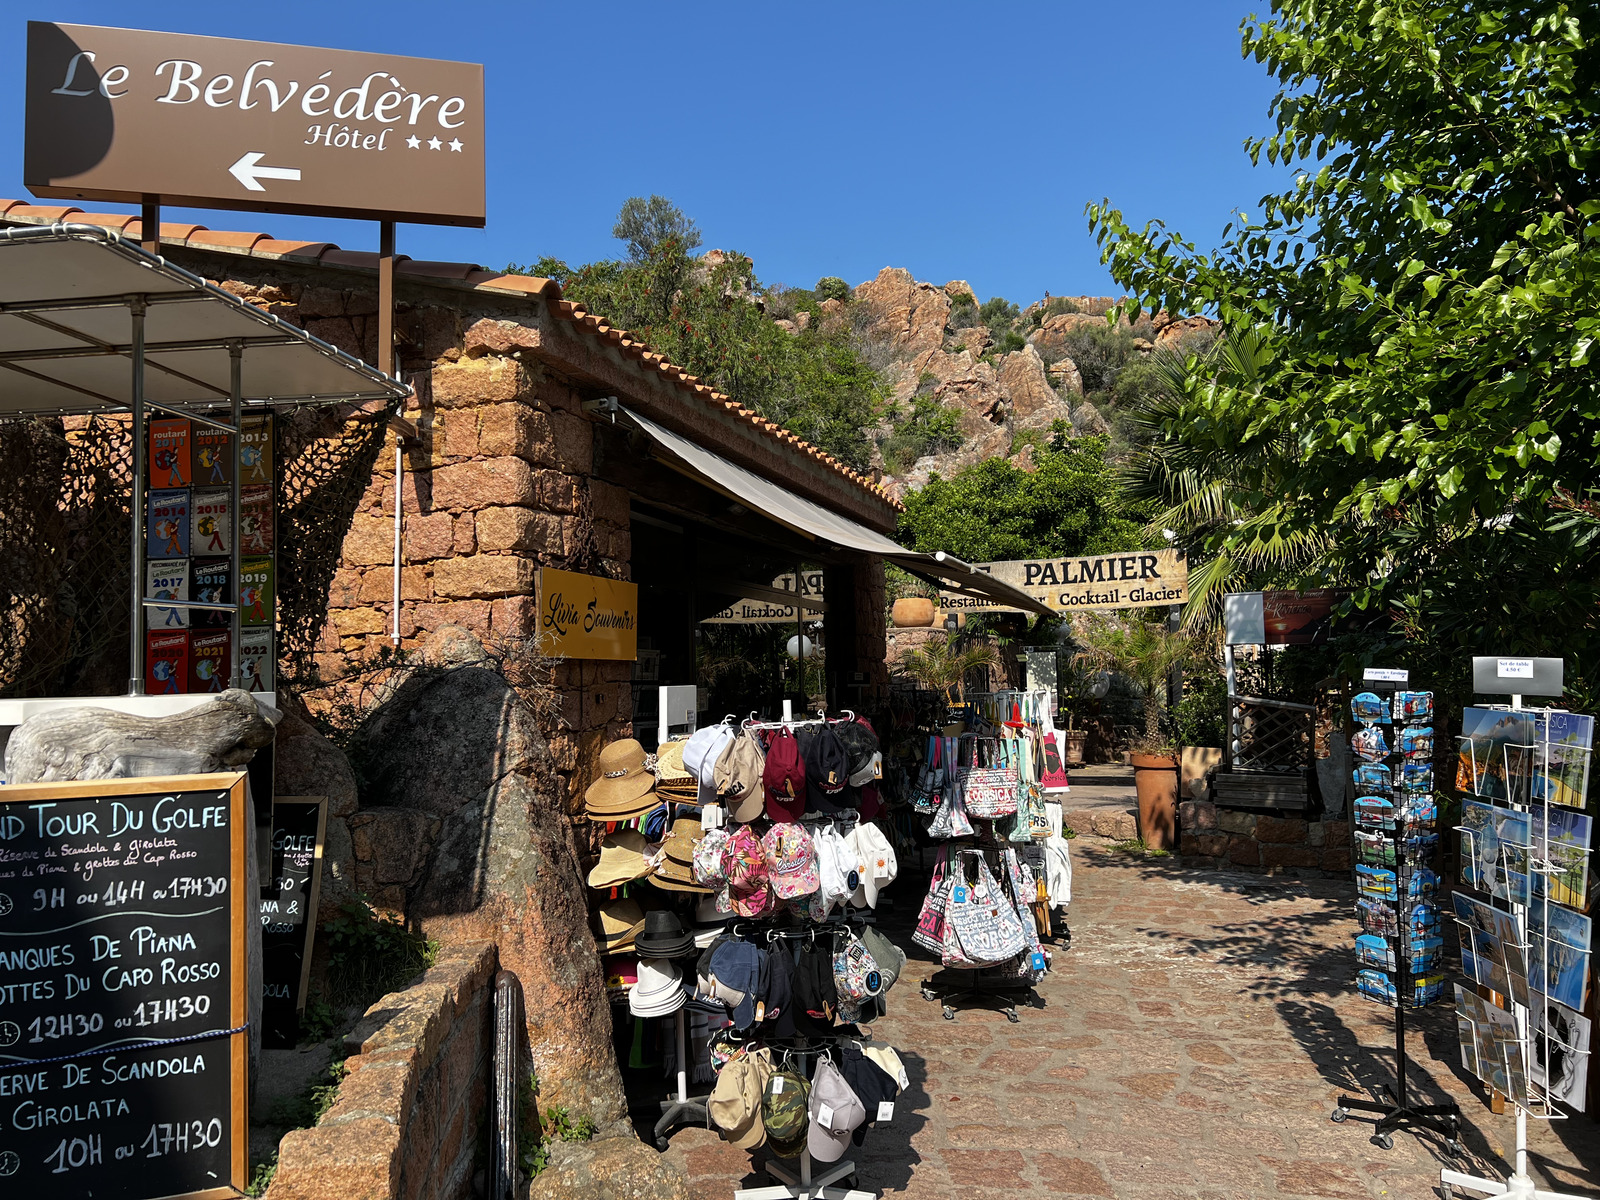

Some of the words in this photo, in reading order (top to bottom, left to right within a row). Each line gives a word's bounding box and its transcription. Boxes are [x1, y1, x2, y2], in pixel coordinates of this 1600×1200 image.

[51, 51, 130, 99] Le
[154, 59, 466, 129] Belvédère
[304, 124, 394, 152] Hôtel
[153, 429, 187, 439] routard
[197, 435, 228, 446] 2012
[240, 433, 269, 443] 2013
[155, 438, 185, 448] 2011
[154, 507, 186, 517] 2014
[197, 505, 227, 514] 2015
[202, 563, 228, 573] Routard
[1024, 555, 1161, 586] PALMIER
[153, 578, 184, 588] 2017
[196, 575, 226, 585] 2018
[240, 573, 268, 583] 2019
[543, 593, 581, 636] Livia
[583, 596, 636, 633] Souvenirs
[159, 636, 185, 646] Routard
[201, 635, 227, 645] Routard
[195, 647, 224, 656] 2021
[1044, 774, 1066, 782] Corsica
[972, 788, 1011, 802] CORSICA
[28, 802, 100, 838] TOUR
[107, 801, 144, 837] DU
[272, 828, 315, 851] GOLFE
[44, 846, 58, 858] de
[61, 843, 109, 857] Scandola
[113, 842, 122, 852] &
[22, 865, 34, 877] de
[37, 863, 68, 875] Piana
[73, 861, 81, 872] &
[123, 857, 138, 867] du
[143, 852, 165, 867] Capo
[169, 849, 198, 861] Rosso
[776, 856, 807, 873] Corsica
[33, 887, 65, 911] 9H
[76, 893, 98, 905] ou
[102, 880, 145, 907] 14H
[153, 889, 168, 900] ou
[168, 876, 228, 900] 17H30
[286, 900, 299, 915] &
[89, 934, 122, 962] DE
[64, 973, 91, 1000] DU
[102, 965, 154, 992] CAPO
[160, 957, 221, 985] ROSSO
[28, 1012, 104, 1044] 12H30
[114, 1016, 132, 1029] ou
[133, 994, 211, 1027] 17H30
[62, 1063, 92, 1089] DE
[101, 1054, 206, 1085] SCANDOLA
[43, 1133, 103, 1174] 10H
[114, 1143, 135, 1161] ou
[140, 1117, 222, 1159] 17H30
